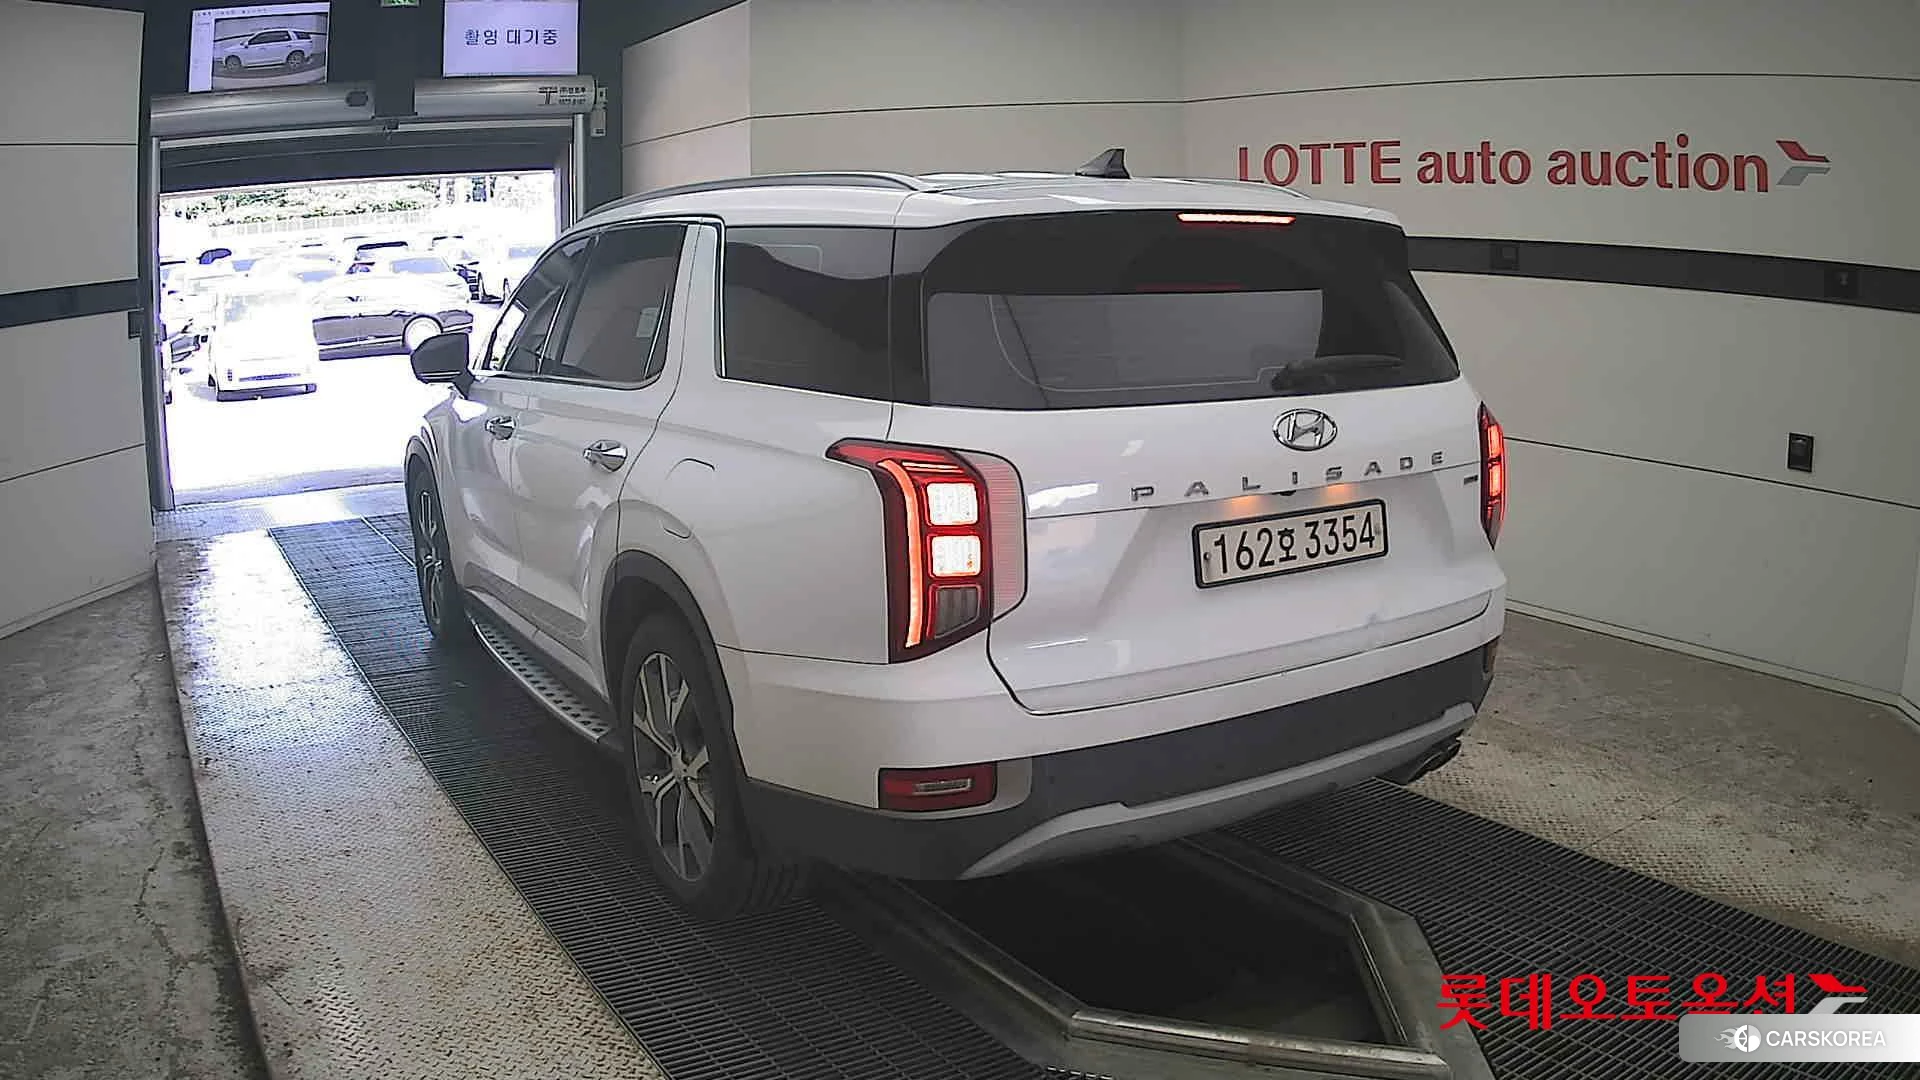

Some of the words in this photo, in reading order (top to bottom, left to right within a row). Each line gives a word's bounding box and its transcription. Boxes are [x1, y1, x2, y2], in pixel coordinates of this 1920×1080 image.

[465, 29, 498, 46] 촬영
[506, 29, 558, 46] 대기중
[1238, 141, 1401, 187] LOTTE
[1416, 141, 1532, 186] auto
[1547, 134, 1769, 193] auction
[1130, 451, 1446, 501] PALISADE
